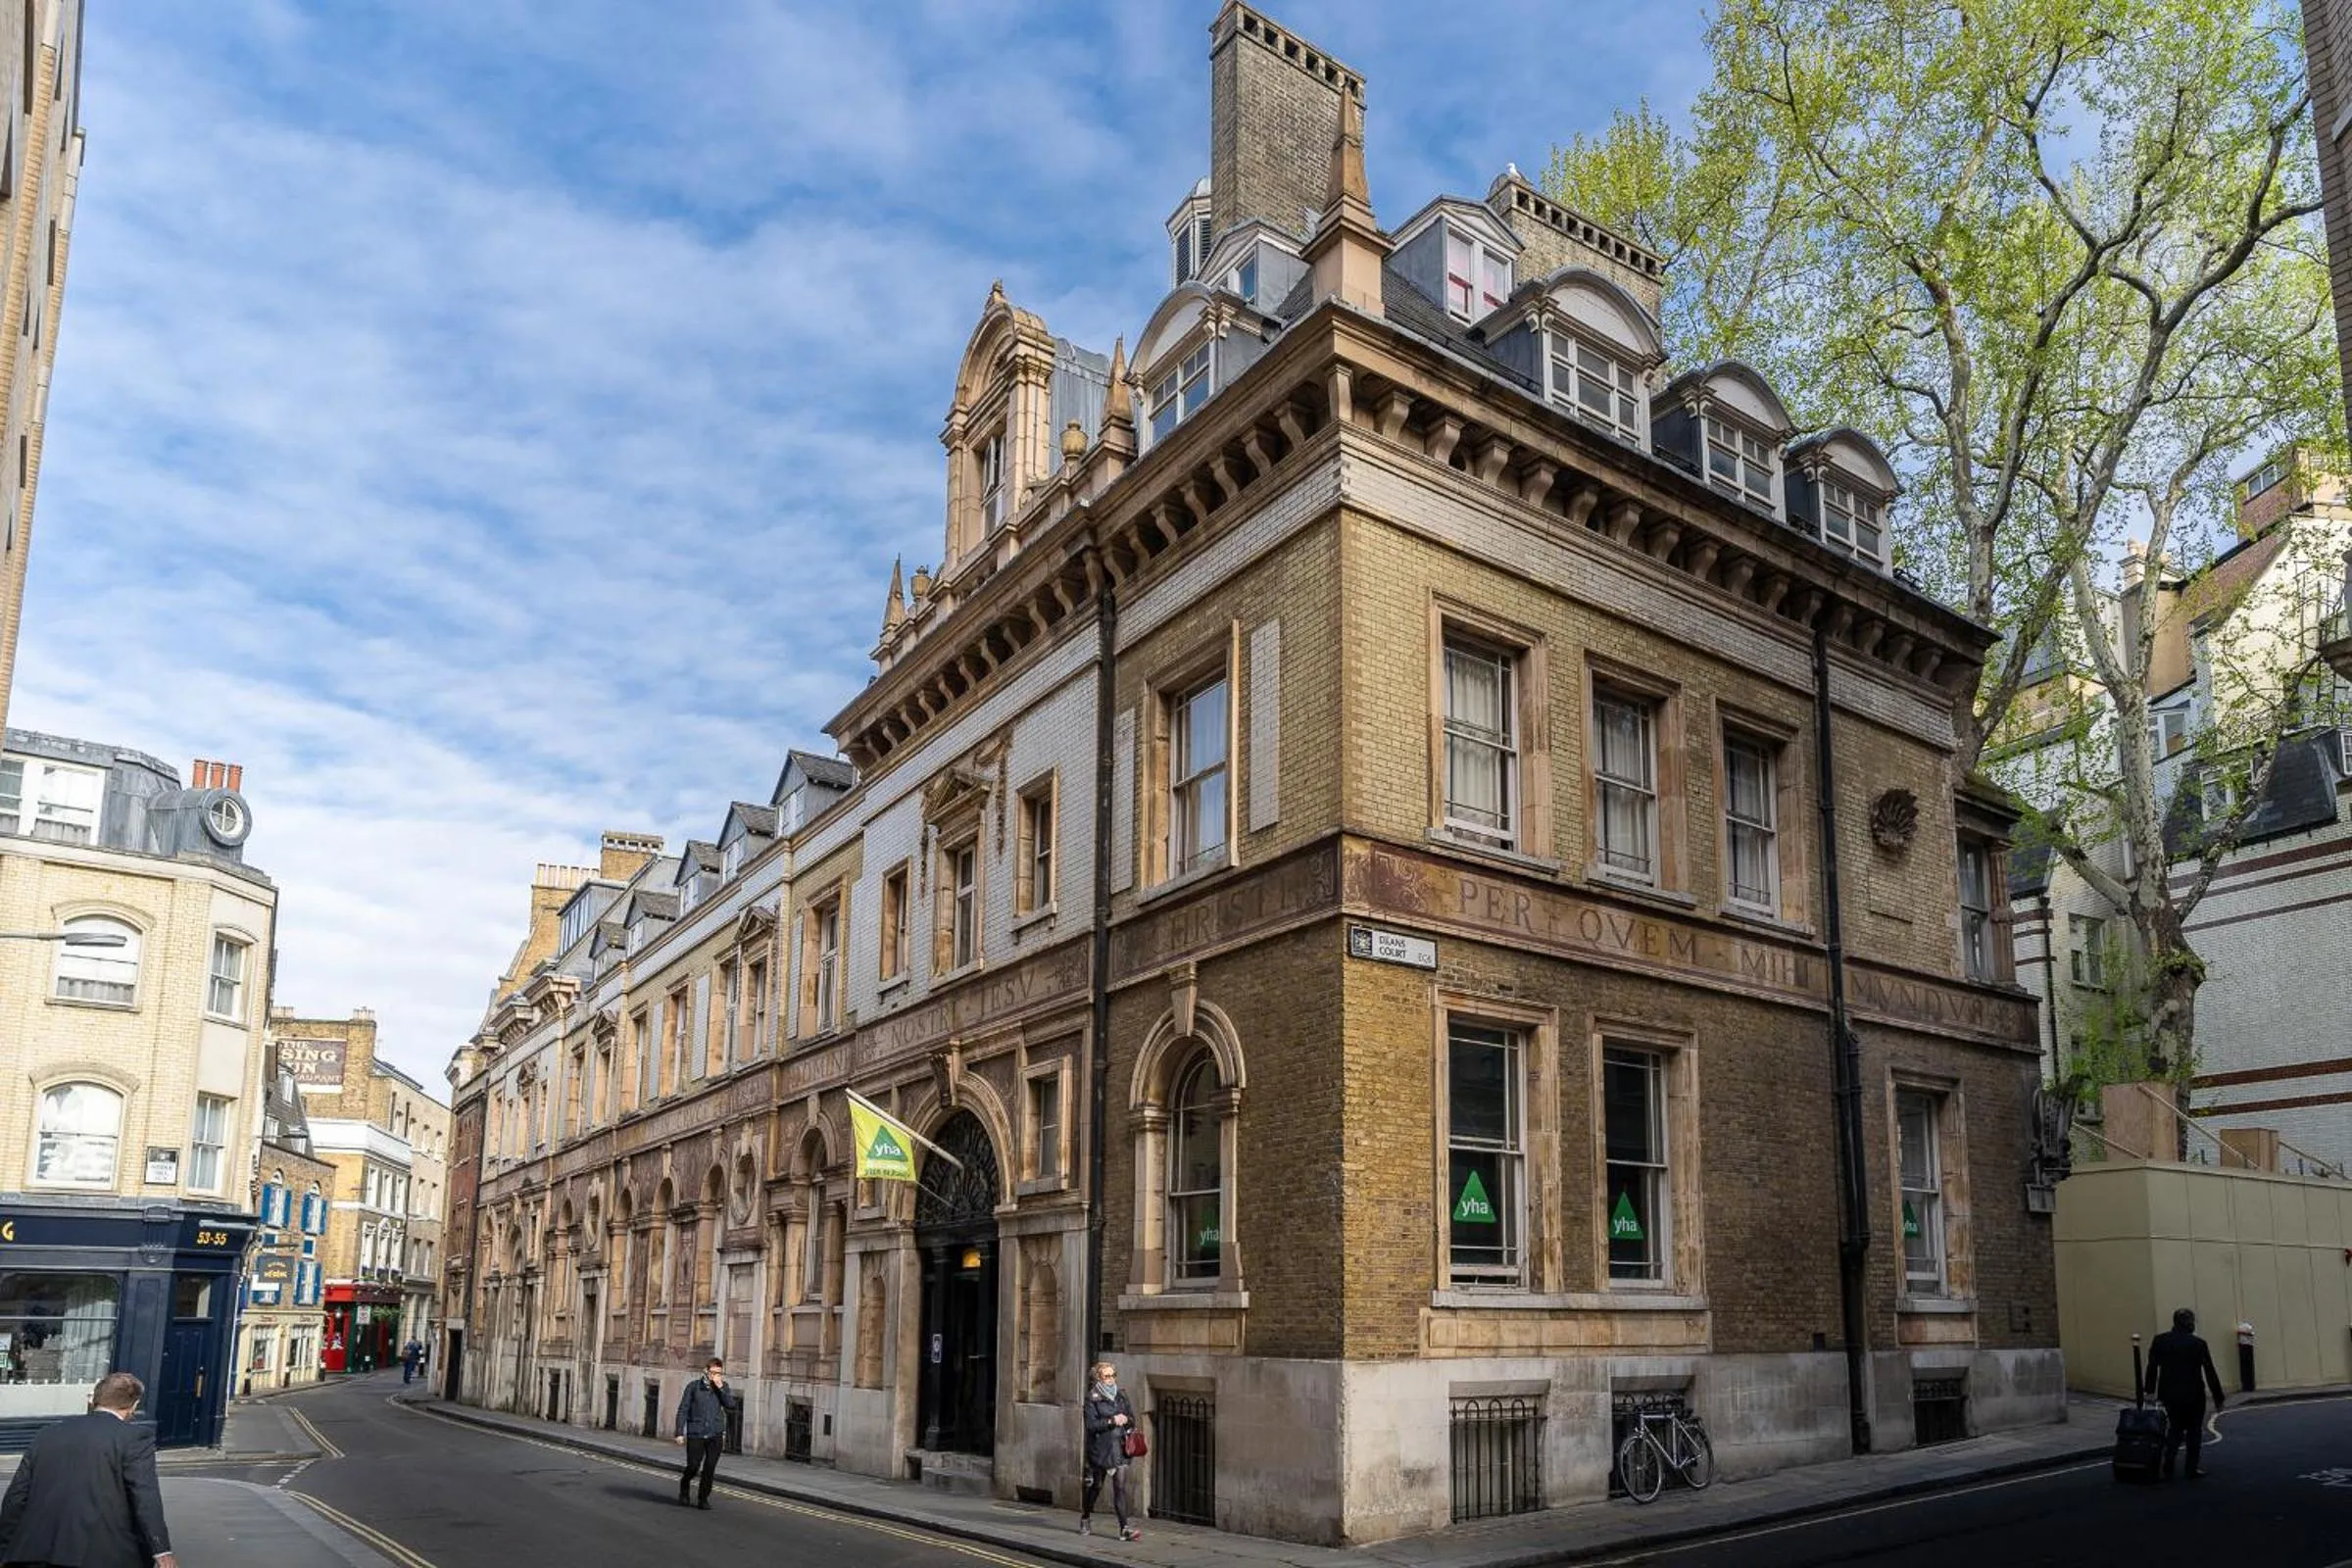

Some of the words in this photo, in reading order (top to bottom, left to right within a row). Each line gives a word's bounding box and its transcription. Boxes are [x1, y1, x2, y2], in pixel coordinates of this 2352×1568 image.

[1457, 879, 1532, 934] PER
[1579, 907, 1698, 965] QVEM
[1379, 935, 1406, 948] DEANS
[1379, 947, 1406, 958] COURT
[874, 1143, 901, 1155] yha
[1462, 1198, 1489, 1217] yha
[1614, 1216, 1637, 1235] yha
[197, 1231, 227, 1246] 53-55
[1200, 1226, 1219, 1246] yha
